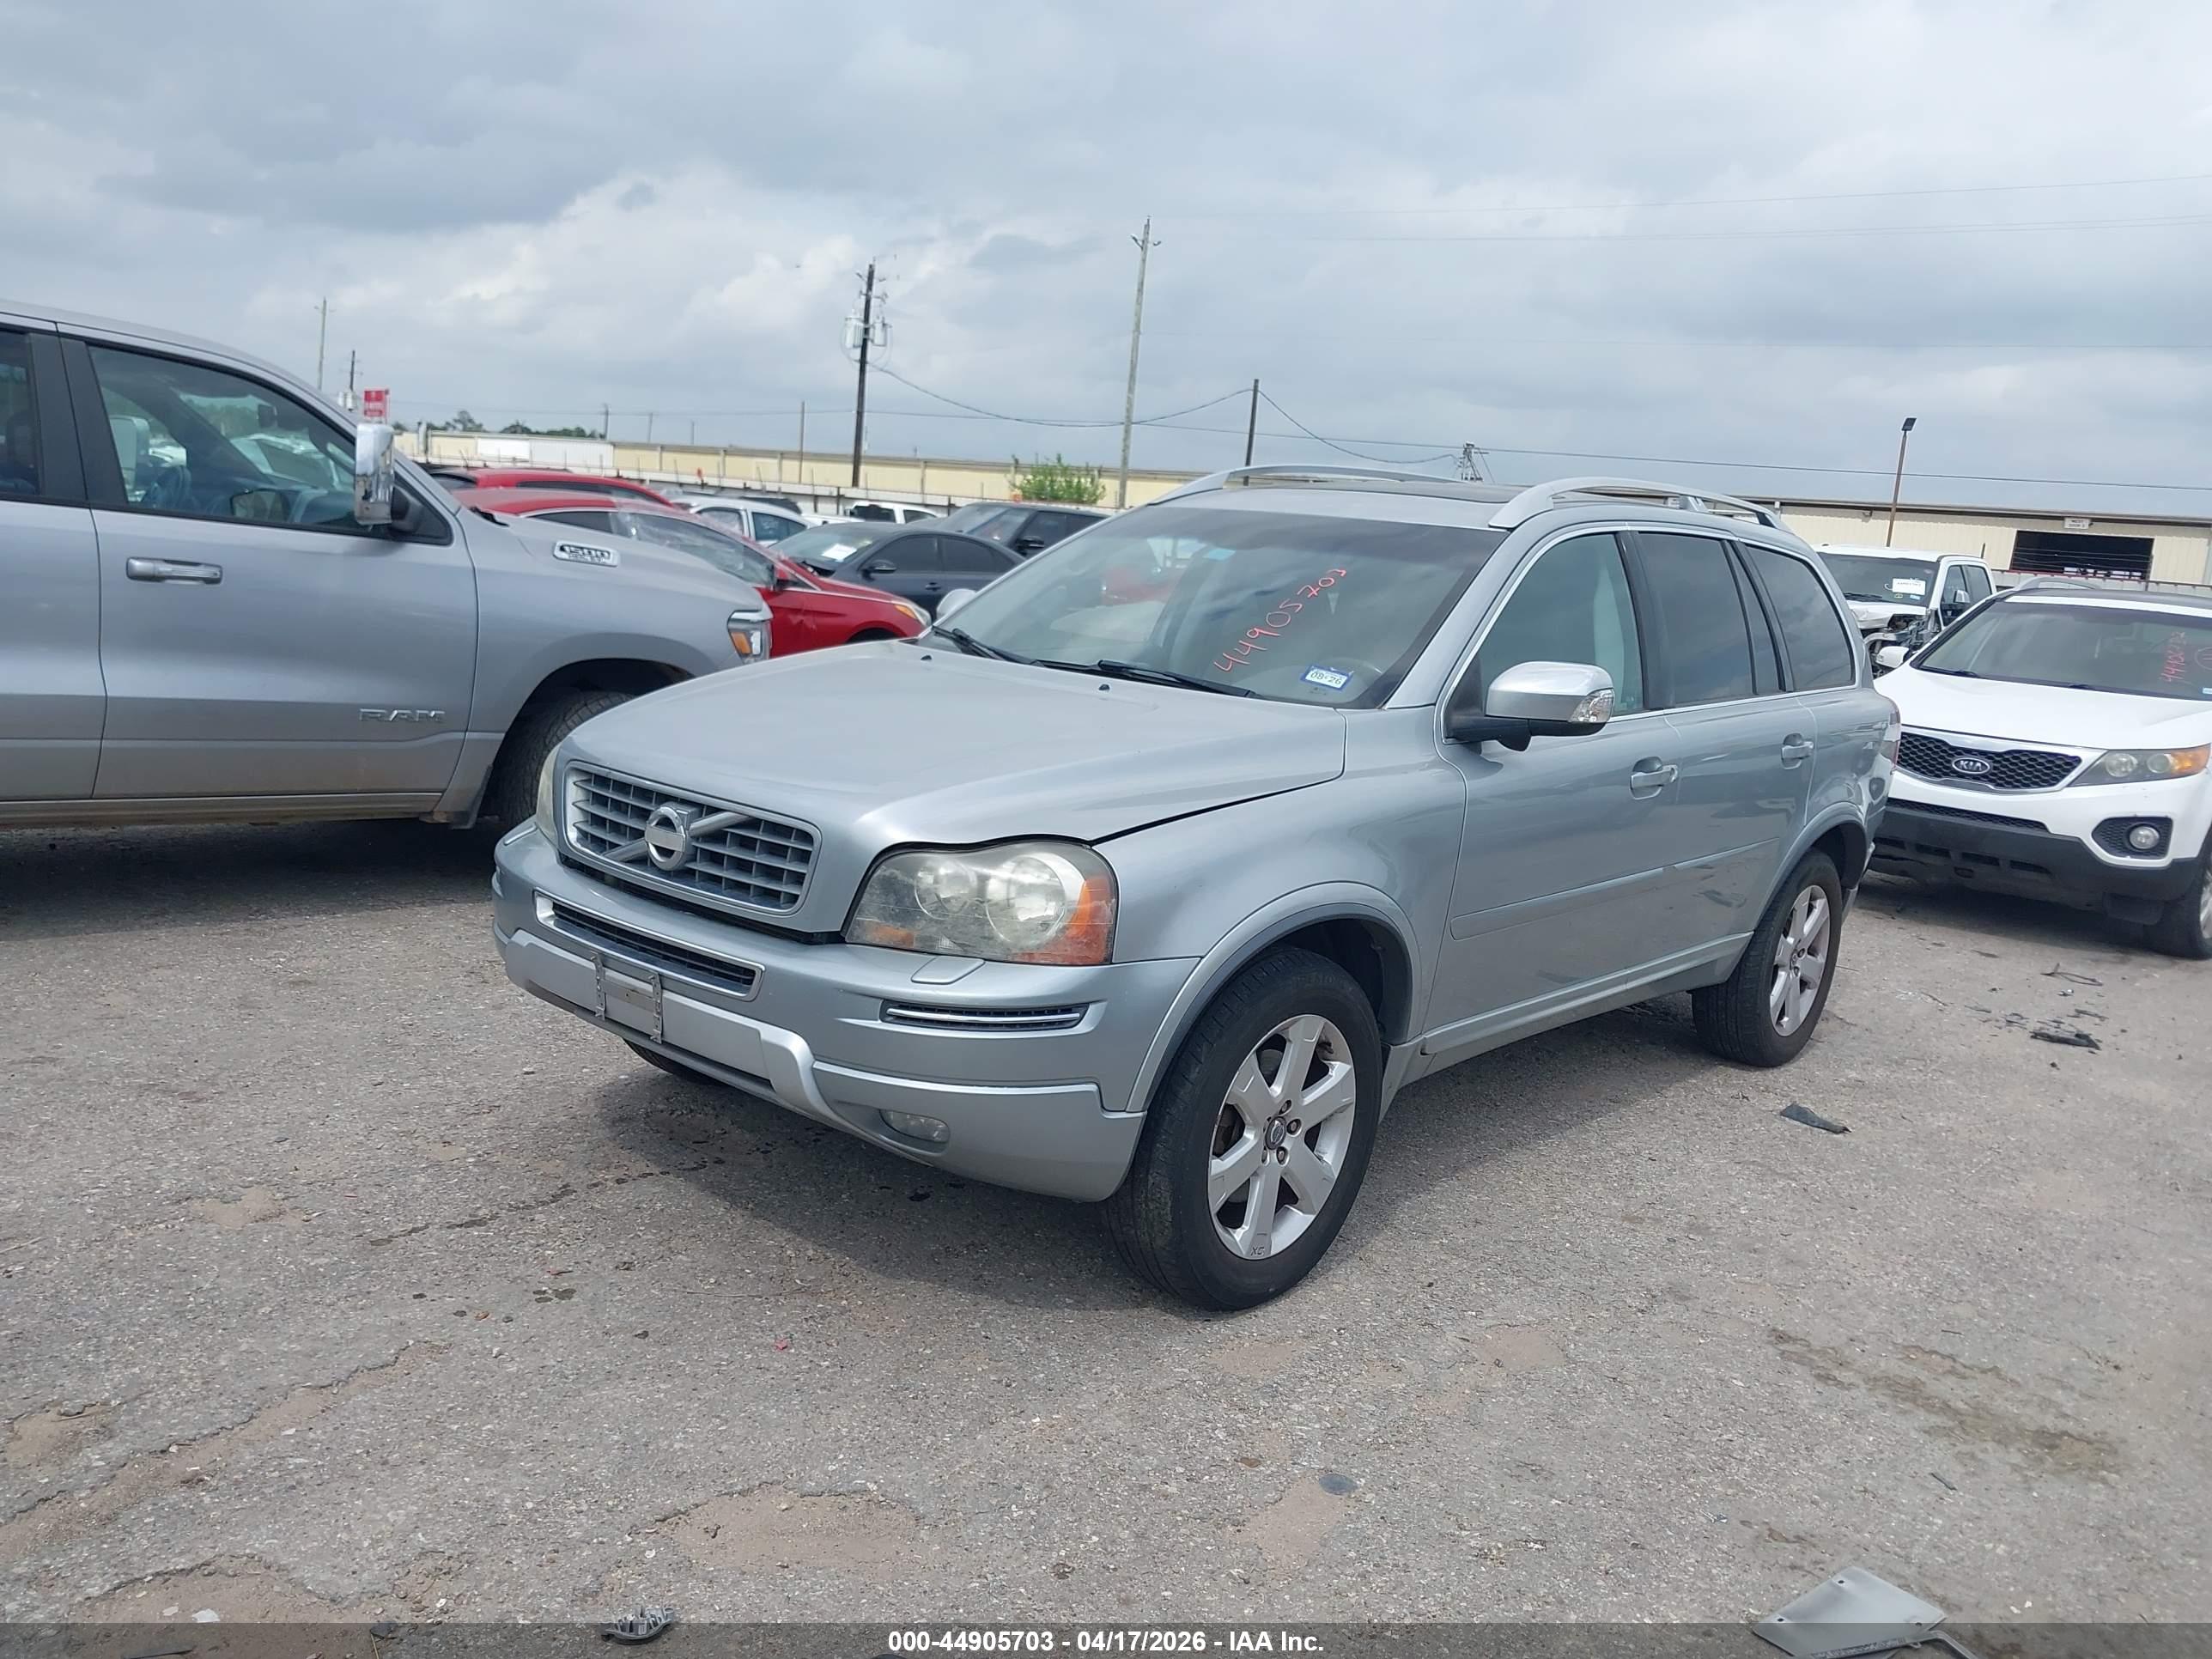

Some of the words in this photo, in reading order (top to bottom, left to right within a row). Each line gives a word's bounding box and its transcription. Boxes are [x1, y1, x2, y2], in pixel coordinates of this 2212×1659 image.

[562, 544, 611, 560] 1500
[359, 708, 446, 723] RAM
[1960, 760, 1982, 771] KIA
